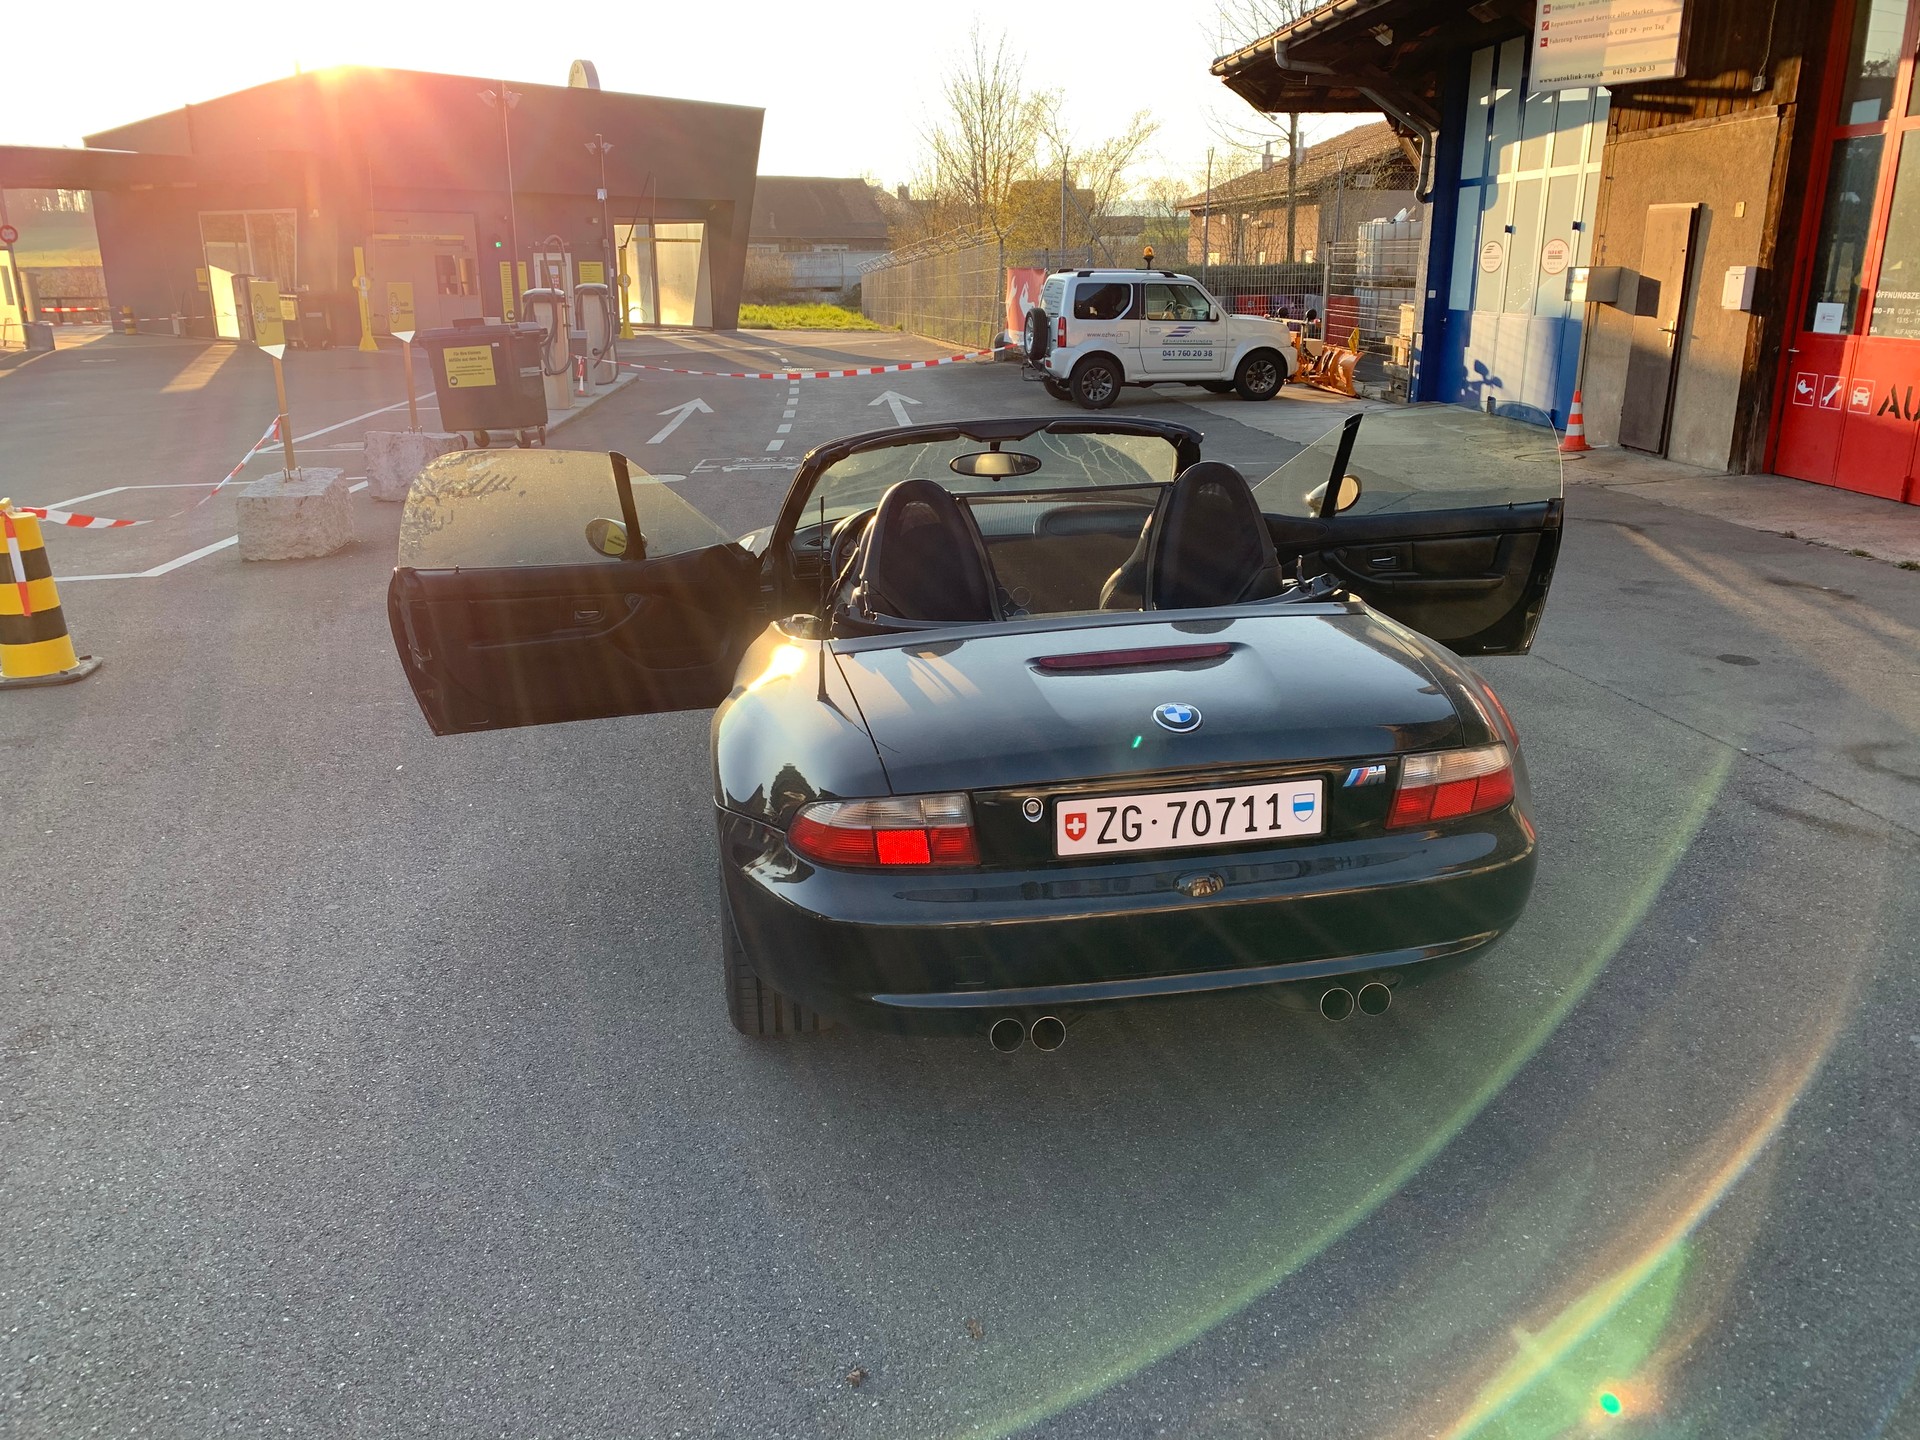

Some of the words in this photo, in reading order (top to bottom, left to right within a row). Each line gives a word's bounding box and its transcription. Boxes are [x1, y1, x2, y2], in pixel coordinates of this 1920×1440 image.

[1550, 19, 1582, 28] Reparaturen
[1615, 27, 1628, 35] CHF
[1655, 23, 1664, 31] Tag
